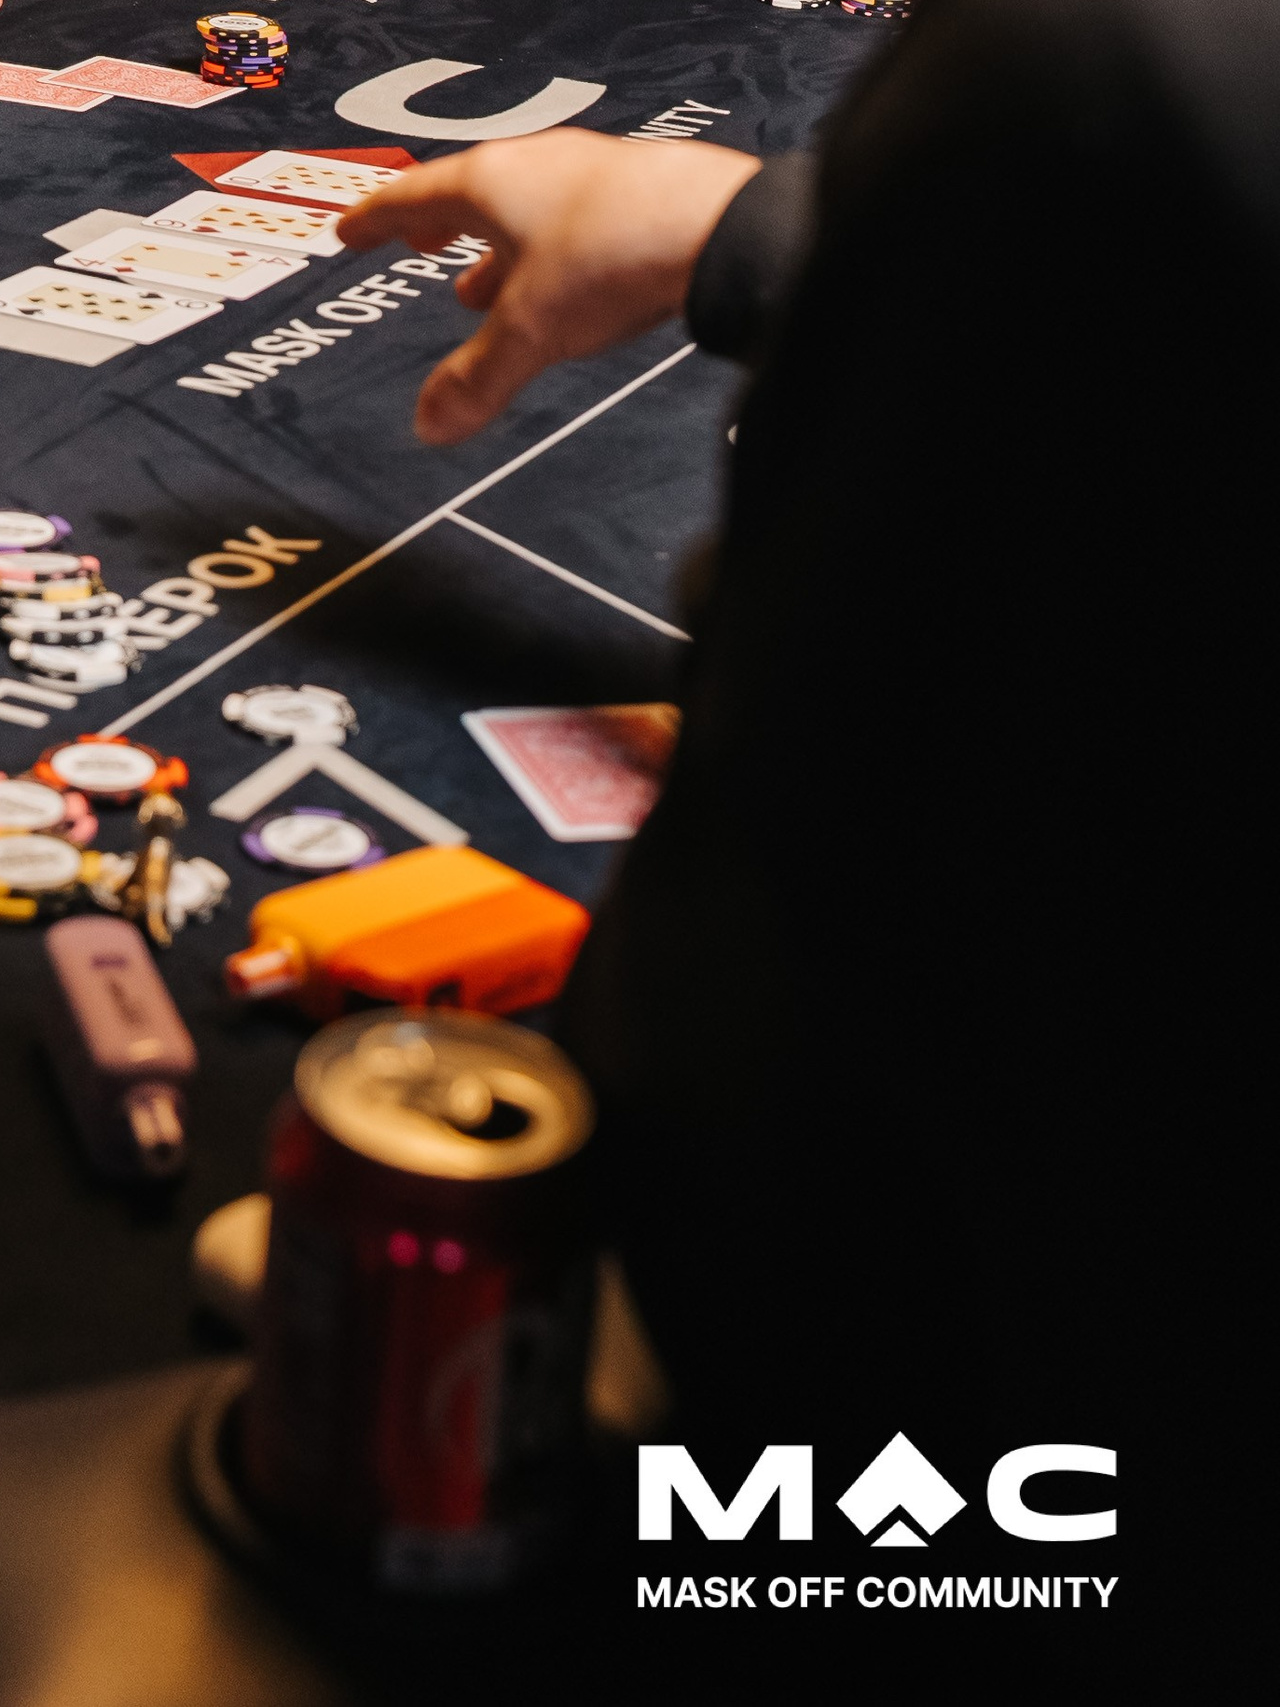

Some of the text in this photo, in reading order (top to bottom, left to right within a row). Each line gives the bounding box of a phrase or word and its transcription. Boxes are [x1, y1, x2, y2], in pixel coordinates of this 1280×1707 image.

[176, 99, 731, 397] MASK OFF POK NITY
